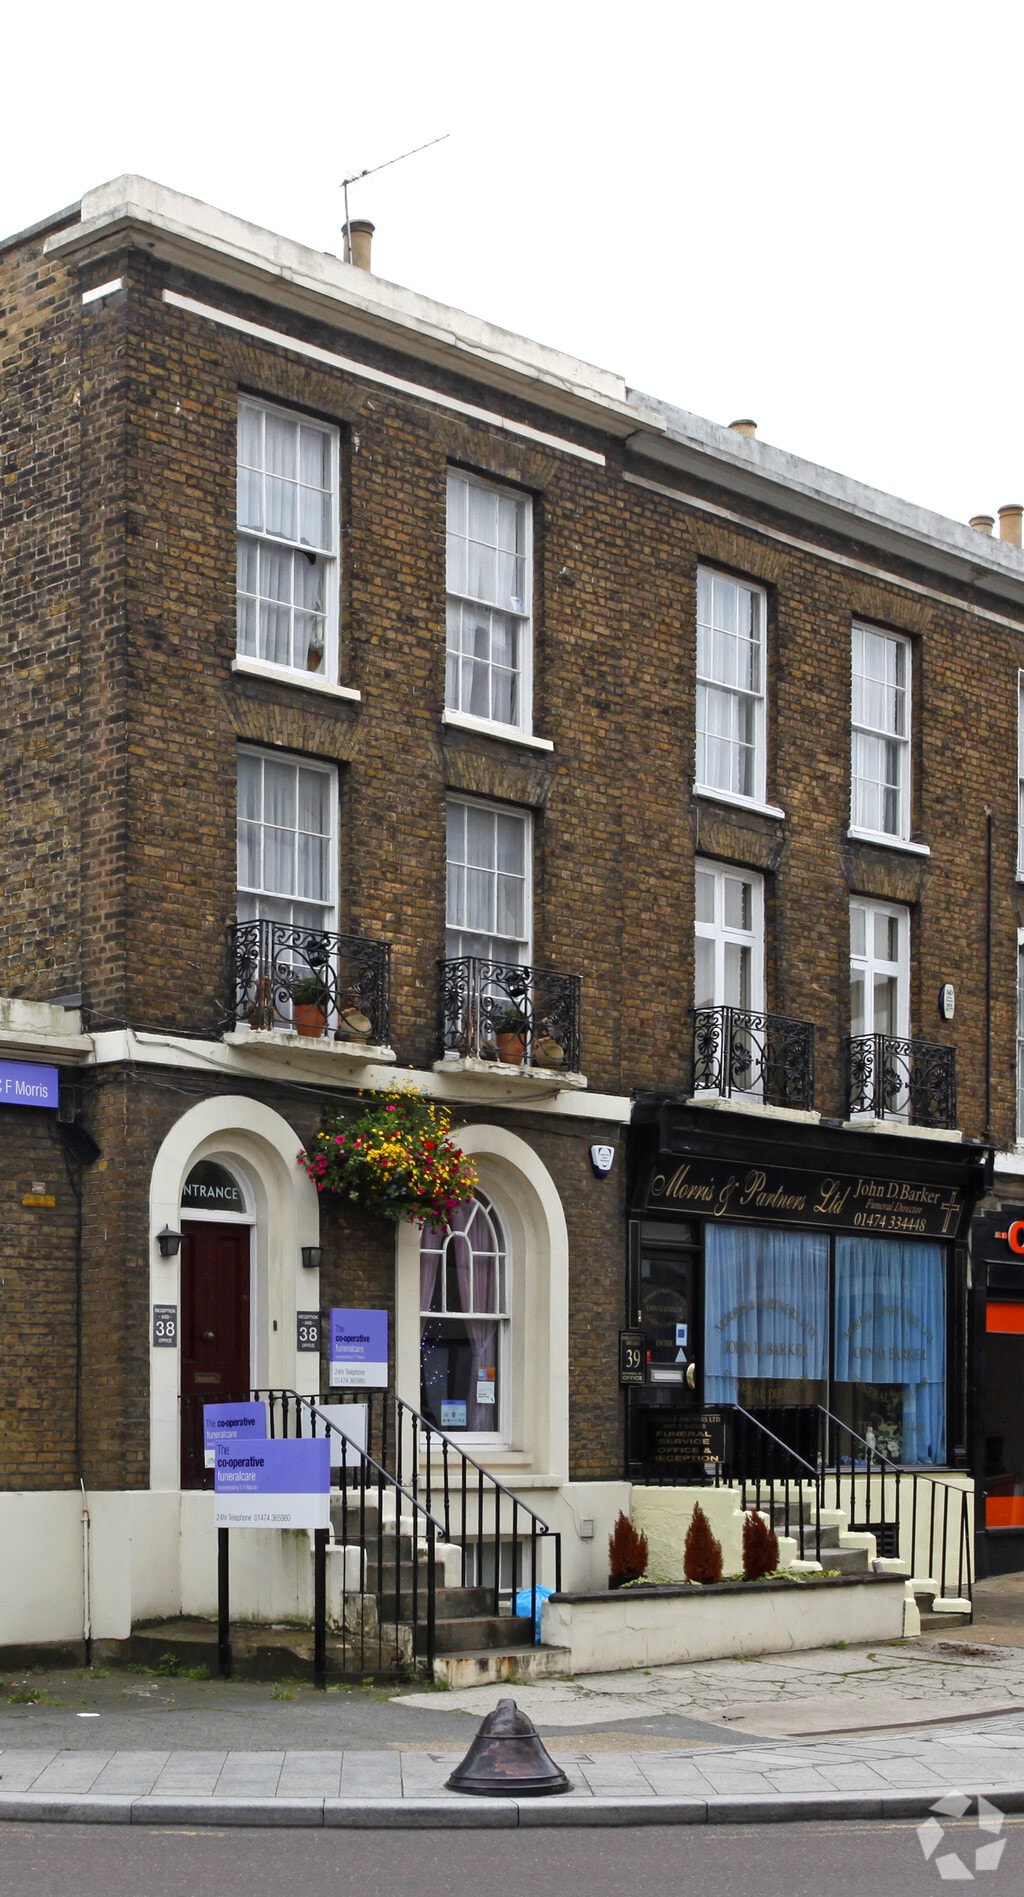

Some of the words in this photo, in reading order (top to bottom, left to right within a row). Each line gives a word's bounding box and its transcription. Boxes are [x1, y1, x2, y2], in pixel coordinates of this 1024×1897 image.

[5, 1079, 12, 1094] F
[15, 1082, 49, 1099] Morris
[651, 1164, 716, 1201] Morris
[713, 1175, 740, 1217] &
[740, 1169, 807, 1211] Partners
[813, 1178, 852, 1214] Ltd
[853, 1179, 885, 1198] John
[865, 1198, 894, 1211] Funeral
[894, 1201, 924, 1214] Director
[853, 1212, 887, 1228] 01474
[888, 1216, 927, 1232] 334448
[155, 1321, 175, 1337] 38
[299, 1327, 318, 1342] 38
[335, 1324, 345, 1333] The
[335, 1334, 371, 1344] co-operative
[335, 1344, 365, 1353] funeralcare
[766, 1342, 809, 1358] BARKER
[625, 1348, 641, 1368] 39
[206, 1418, 216, 1429] The
[216, 1417, 256, 1429] co-operative
[206, 1429, 238, 1439] funeralcare
[216, 1444, 230, 1456] The
[657, 1446, 700, 1454] OFFICE
[217, 1456, 265, 1469] co-operative
[217, 1470, 256, 1482] funeralcare
[216, 1513, 227, 1522] 24hr
[228, 1513, 252, 1523] Telephone
[253, 1513, 271, 1522] 01474
